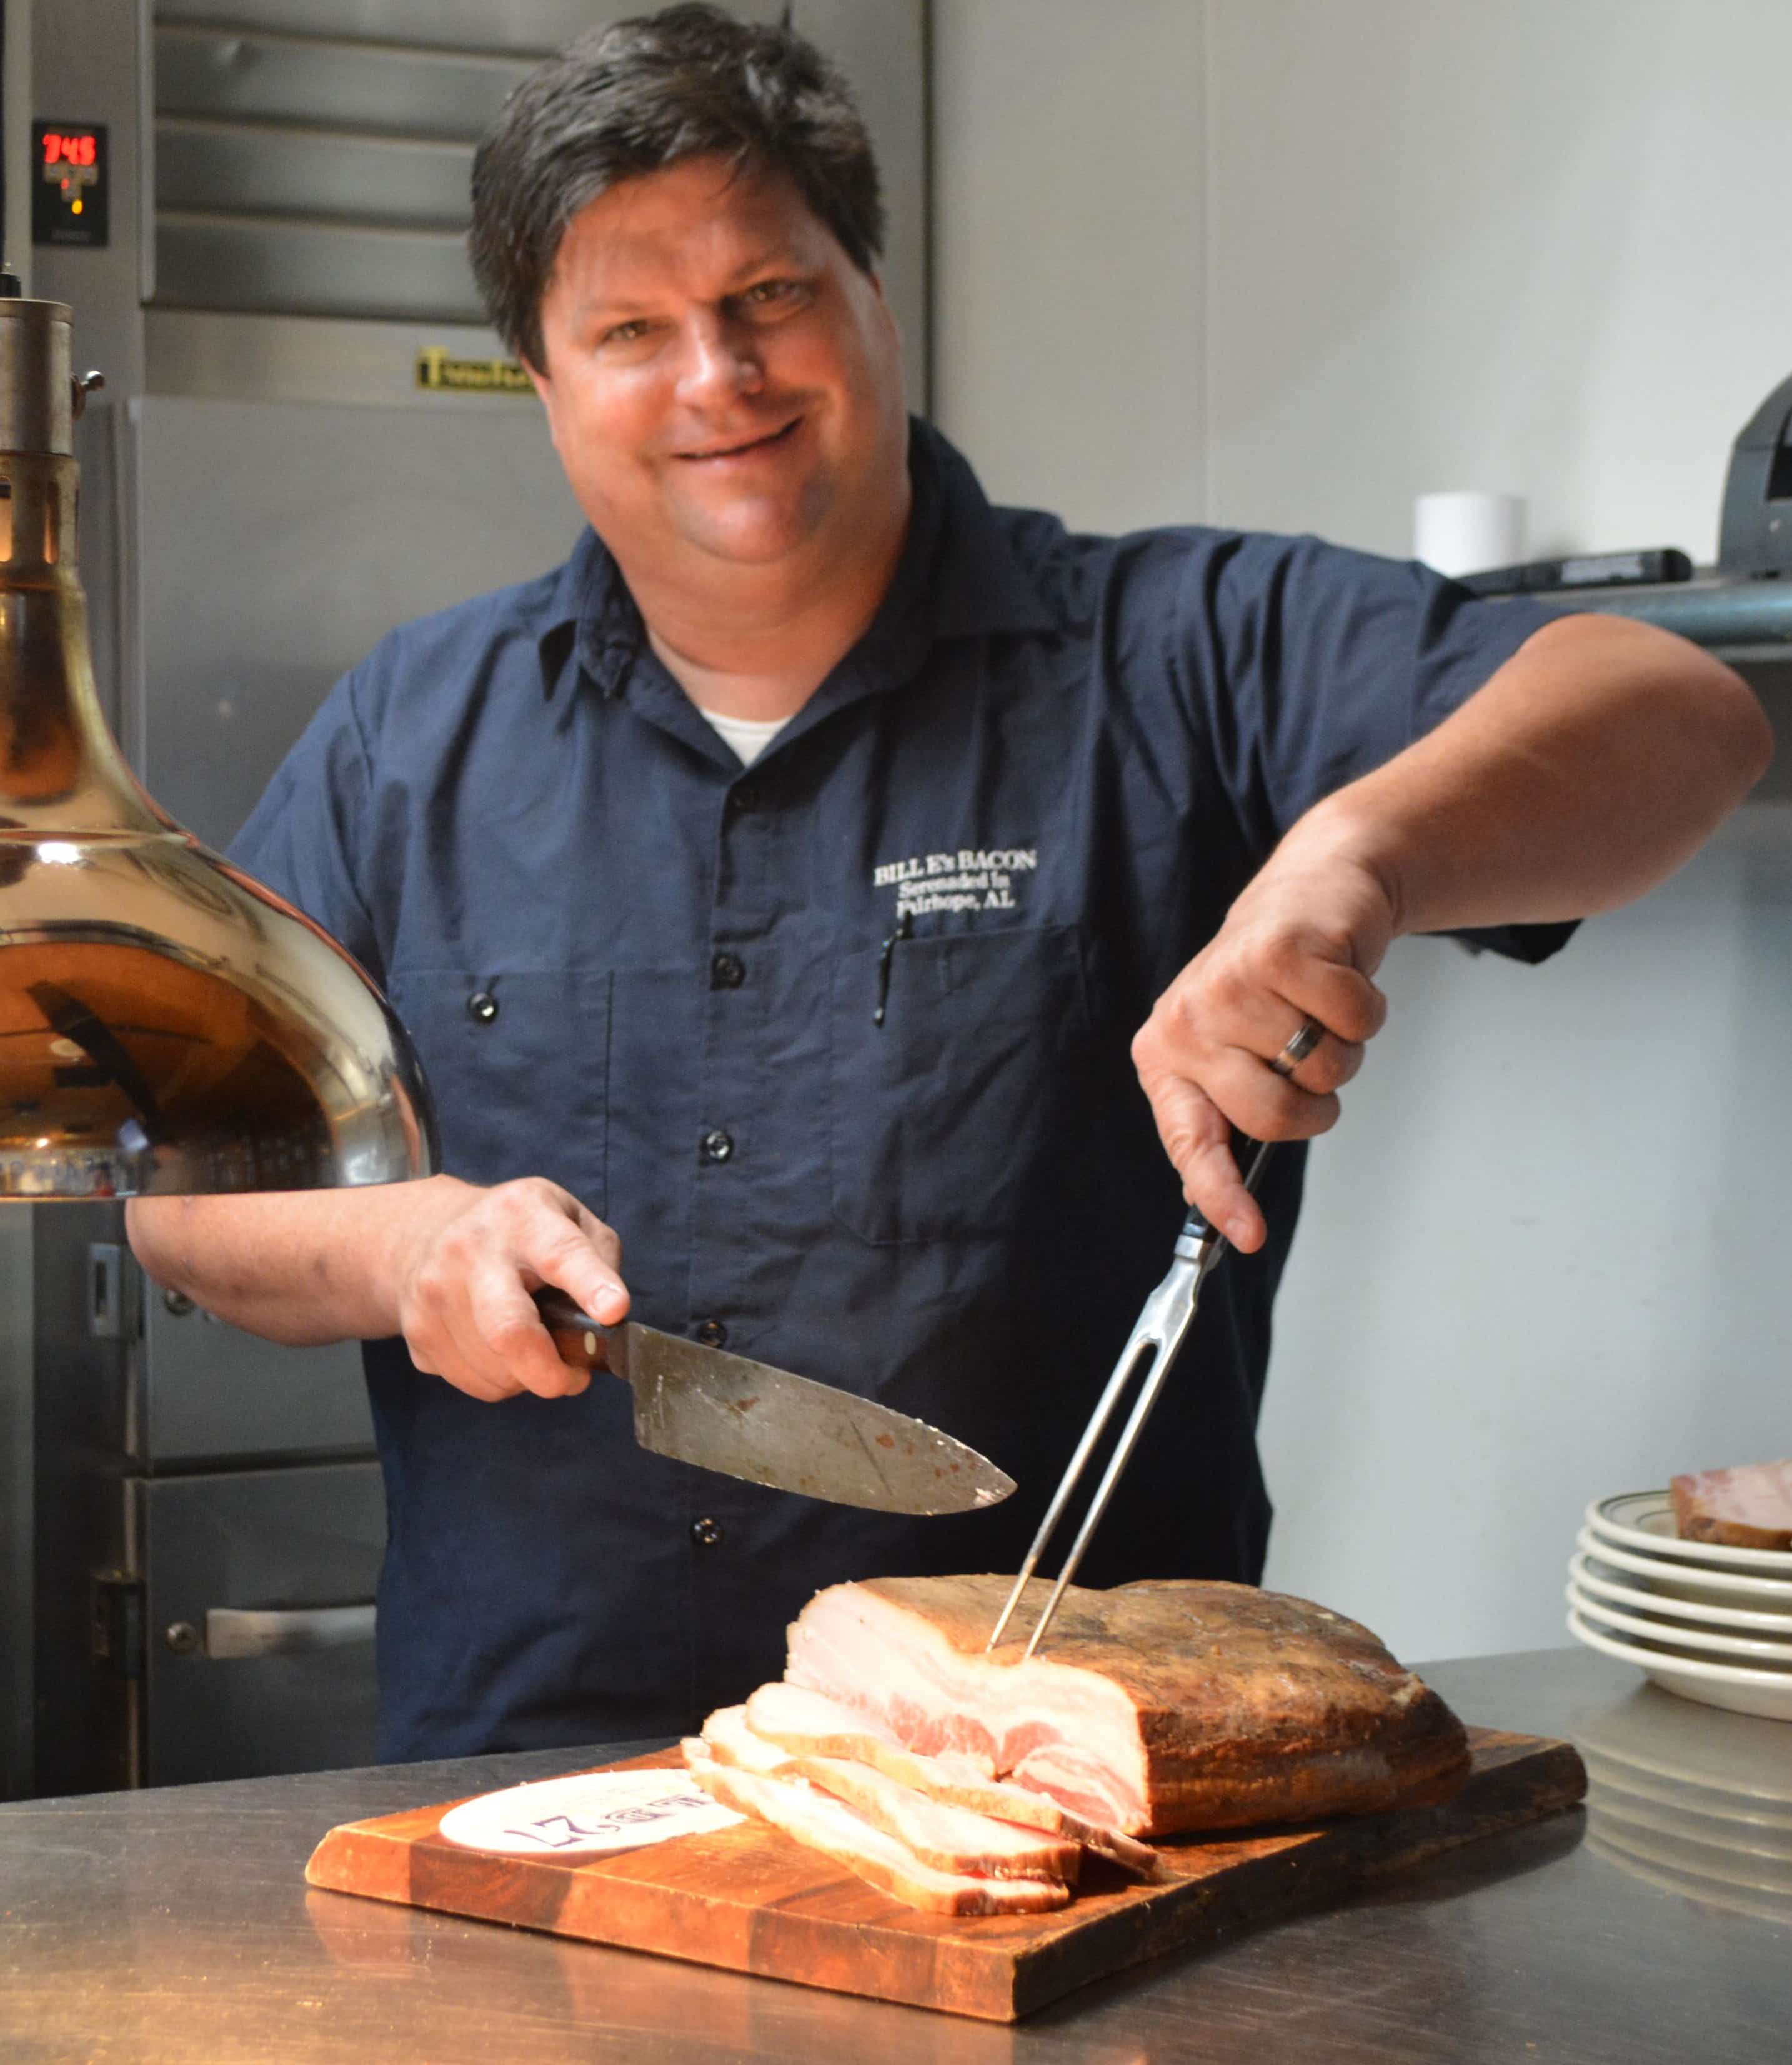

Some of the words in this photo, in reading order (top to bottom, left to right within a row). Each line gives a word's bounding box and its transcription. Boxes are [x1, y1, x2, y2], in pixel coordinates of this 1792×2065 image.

[873, 858, 925, 886] BILL
[957, 849, 1038, 871] BACON
[983, 889, 1016, 909] AL
